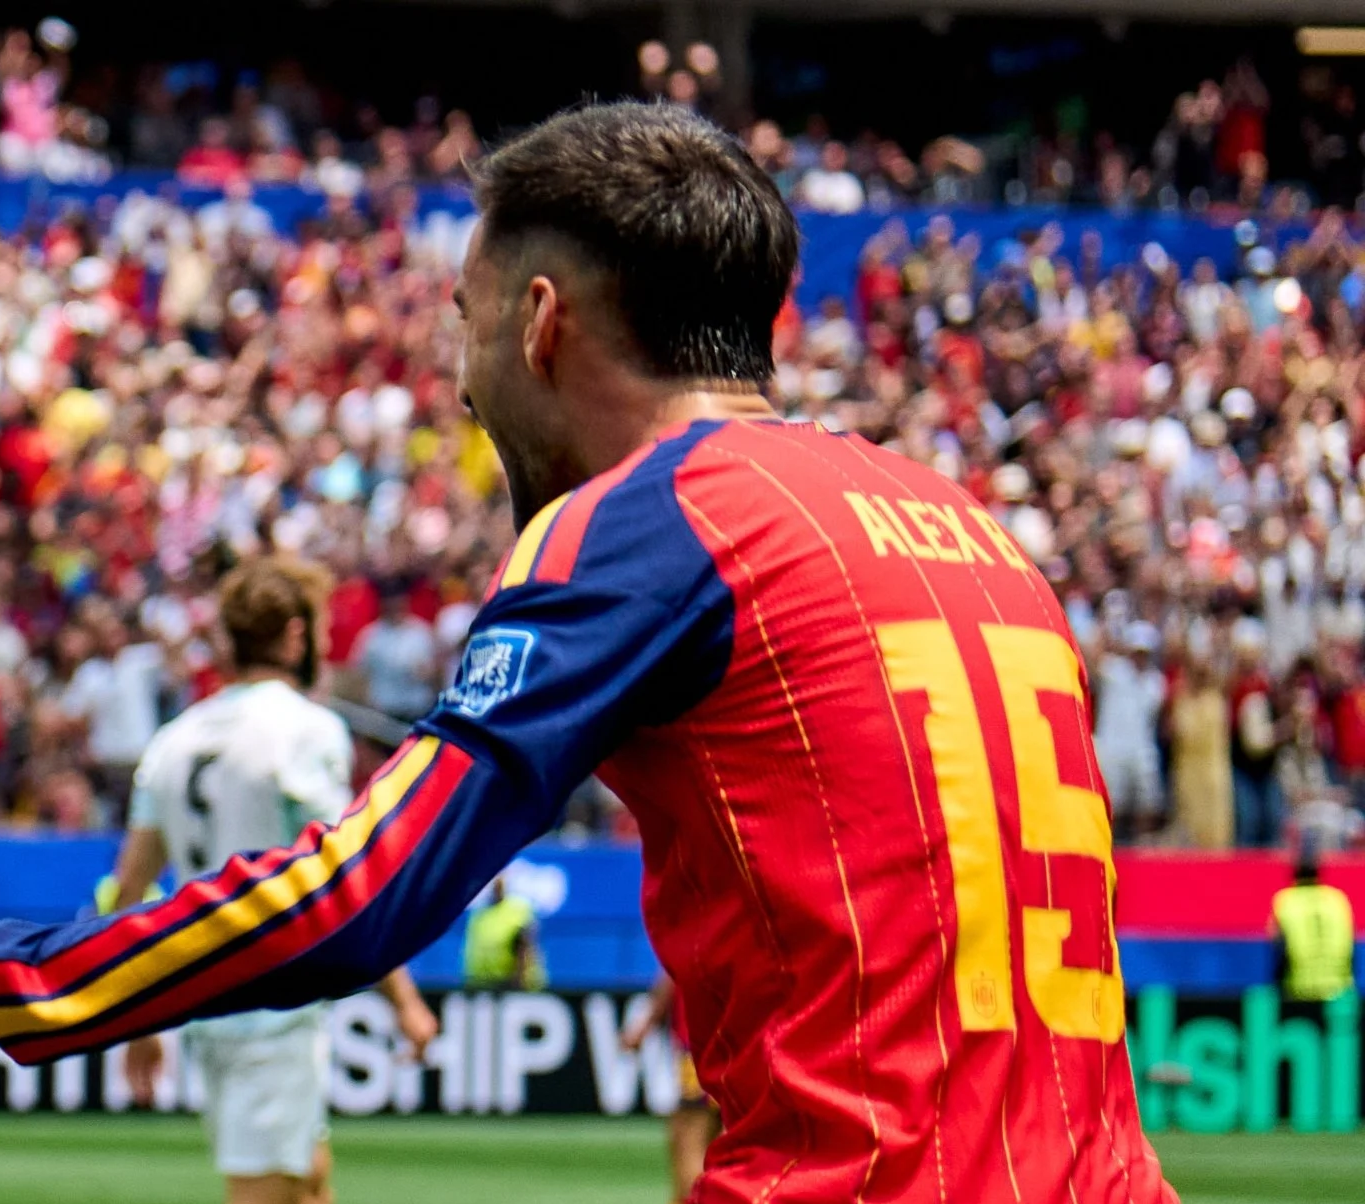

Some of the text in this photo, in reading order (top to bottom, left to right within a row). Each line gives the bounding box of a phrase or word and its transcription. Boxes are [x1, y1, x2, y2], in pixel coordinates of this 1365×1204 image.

[843, 491, 996, 566] ALEX
[875, 618, 1125, 1044] 15
[1131, 982, 1362, 1134] lshi
